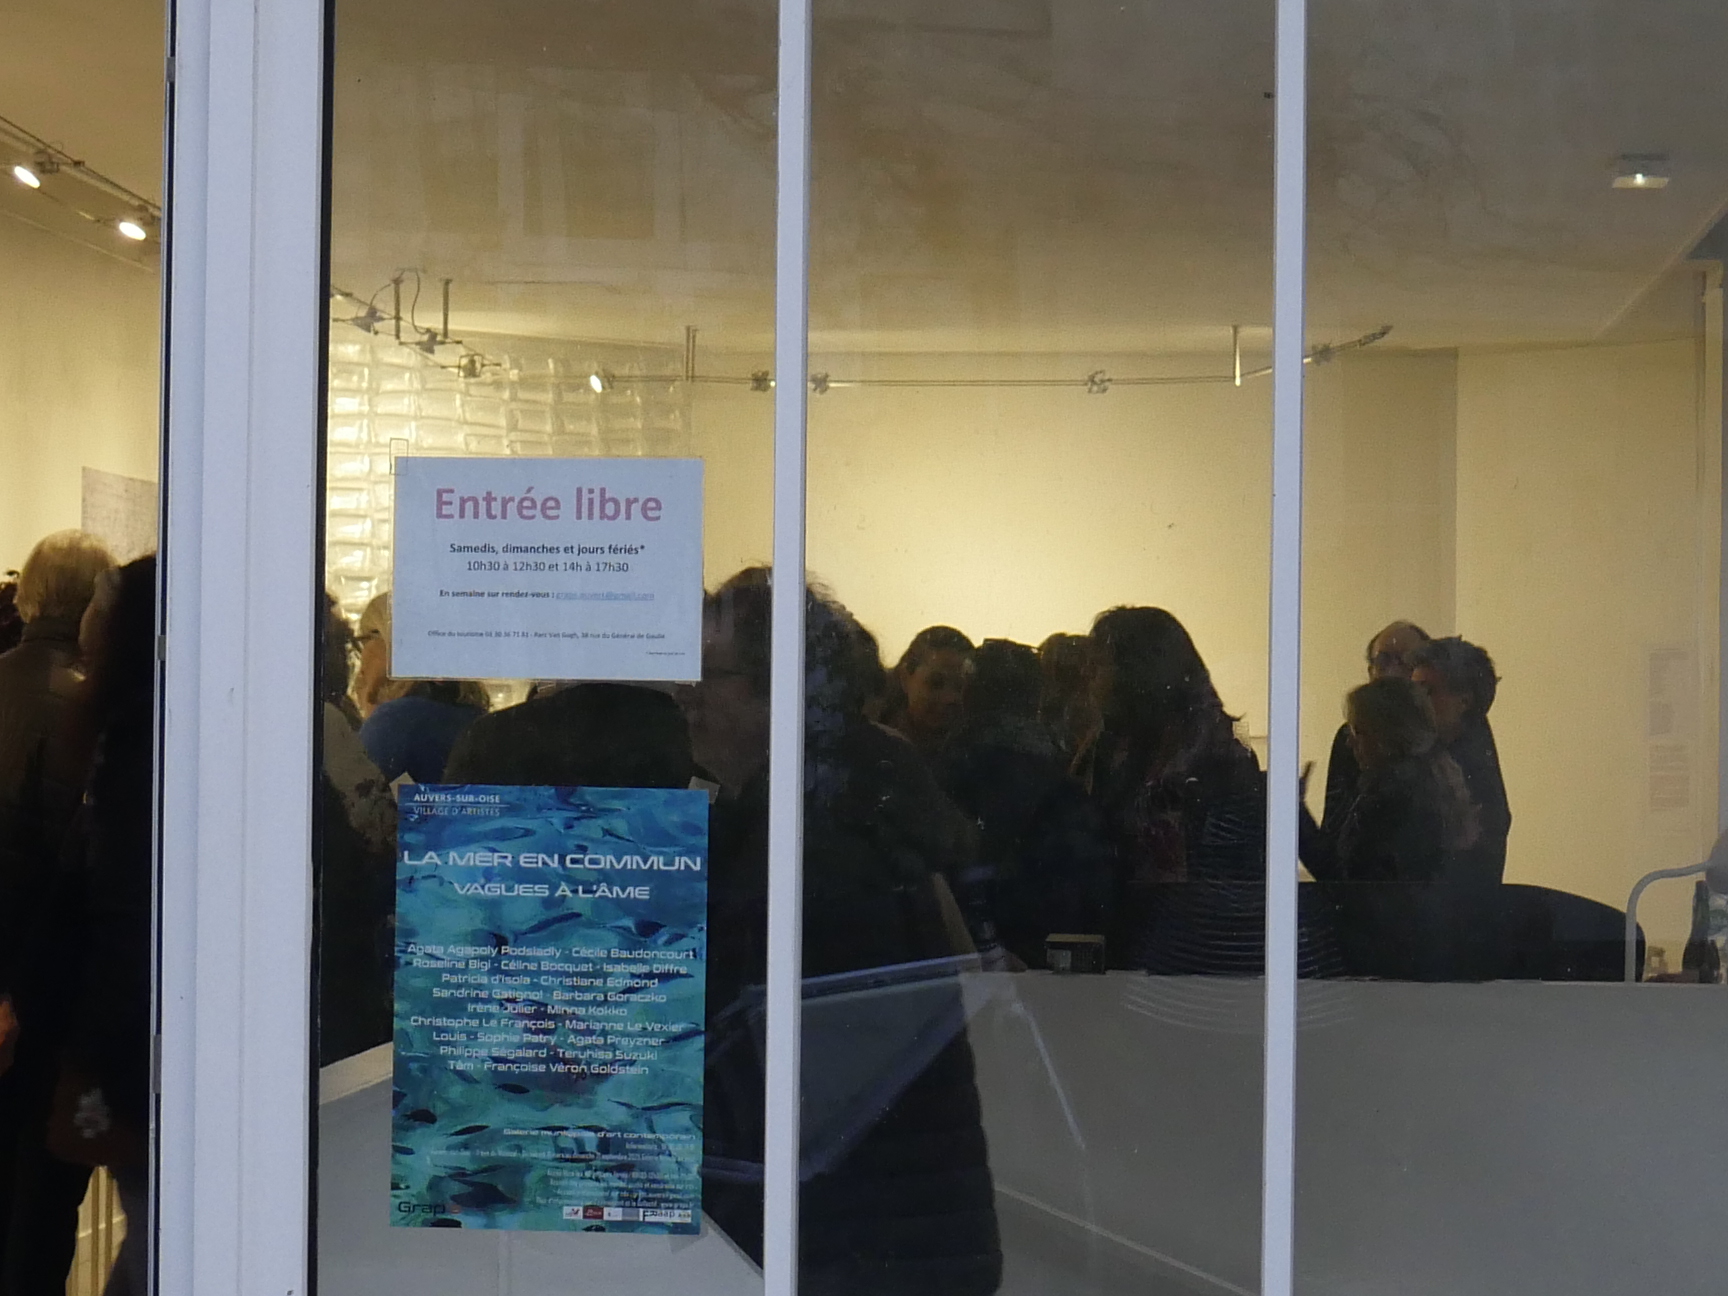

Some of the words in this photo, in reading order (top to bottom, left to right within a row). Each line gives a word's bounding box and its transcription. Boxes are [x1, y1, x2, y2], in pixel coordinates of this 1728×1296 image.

[435, 486, 562, 521] Entrée
[575, 486, 662, 522] libre
[449, 543, 498, 555] Samedis,
[502, 543, 561, 554] dimanches
[564, 545, 575, 554] et
[577, 544, 605, 556] jours
[467, 561, 500, 571] 10h30
[503, 561, 509, 571] à
[513, 561, 545, 572] 12h30
[548, 563, 558, 572] et
[564, 562, 582, 572] 14h
[585, 561, 591, 572] à
[596, 562, 629, 572] 17h30
[451, 590, 485, 598] semaine
[501, 590, 550, 598] rendez-vous
[413, 793, 500, 803] AUVERS-SUR-OISE
[414, 806, 448, 815] VILLAGE
[452, 807, 500, 816] D'ARTISTES
[404, 850, 441, 865] LA
[449, 851, 512, 867] MER
[520, 853, 558, 867] EN
[565, 854, 701, 871] COMMUN
[454, 883, 549, 897] VAGUES
[554, 881, 572, 897] À
[578, 884, 650, 899] L'ÂME
[572, 946, 608, 957] Cécile
[610, 948, 695, 959] Baudoncourt
[500, 959, 538, 970] Céline
[603, 962, 650, 973] Isabelle
[441, 973, 488, 984] Patricia
[540, 975, 603, 986] Christiane
[606, 977, 658, 988] Edmond
[432, 988, 489, 998] Sandrine
[552, 990, 605, 1001] Barbara
[410, 1015, 479, 1028] Christophe
[482, 1017, 497, 1027] Le
[500, 1018, 555, 1031] François
[565, 1019, 624, 1030] Marianne
[627, 1021, 642, 1031] Le
[432, 1031, 467, 1041] Louis
[477, 1032, 520, 1043] Sophie
[522, 1033, 556, 1045] Patry
[567, 1035, 604, 1046] Agata
[439, 1045, 488, 1057] Philippe
[557, 1048, 613, 1059] Teruhisa
[615, 1049, 658, 1060] Suzuki
[484, 1062, 546, 1074] Françoise
[590, 1063, 649, 1075] Goldstein
